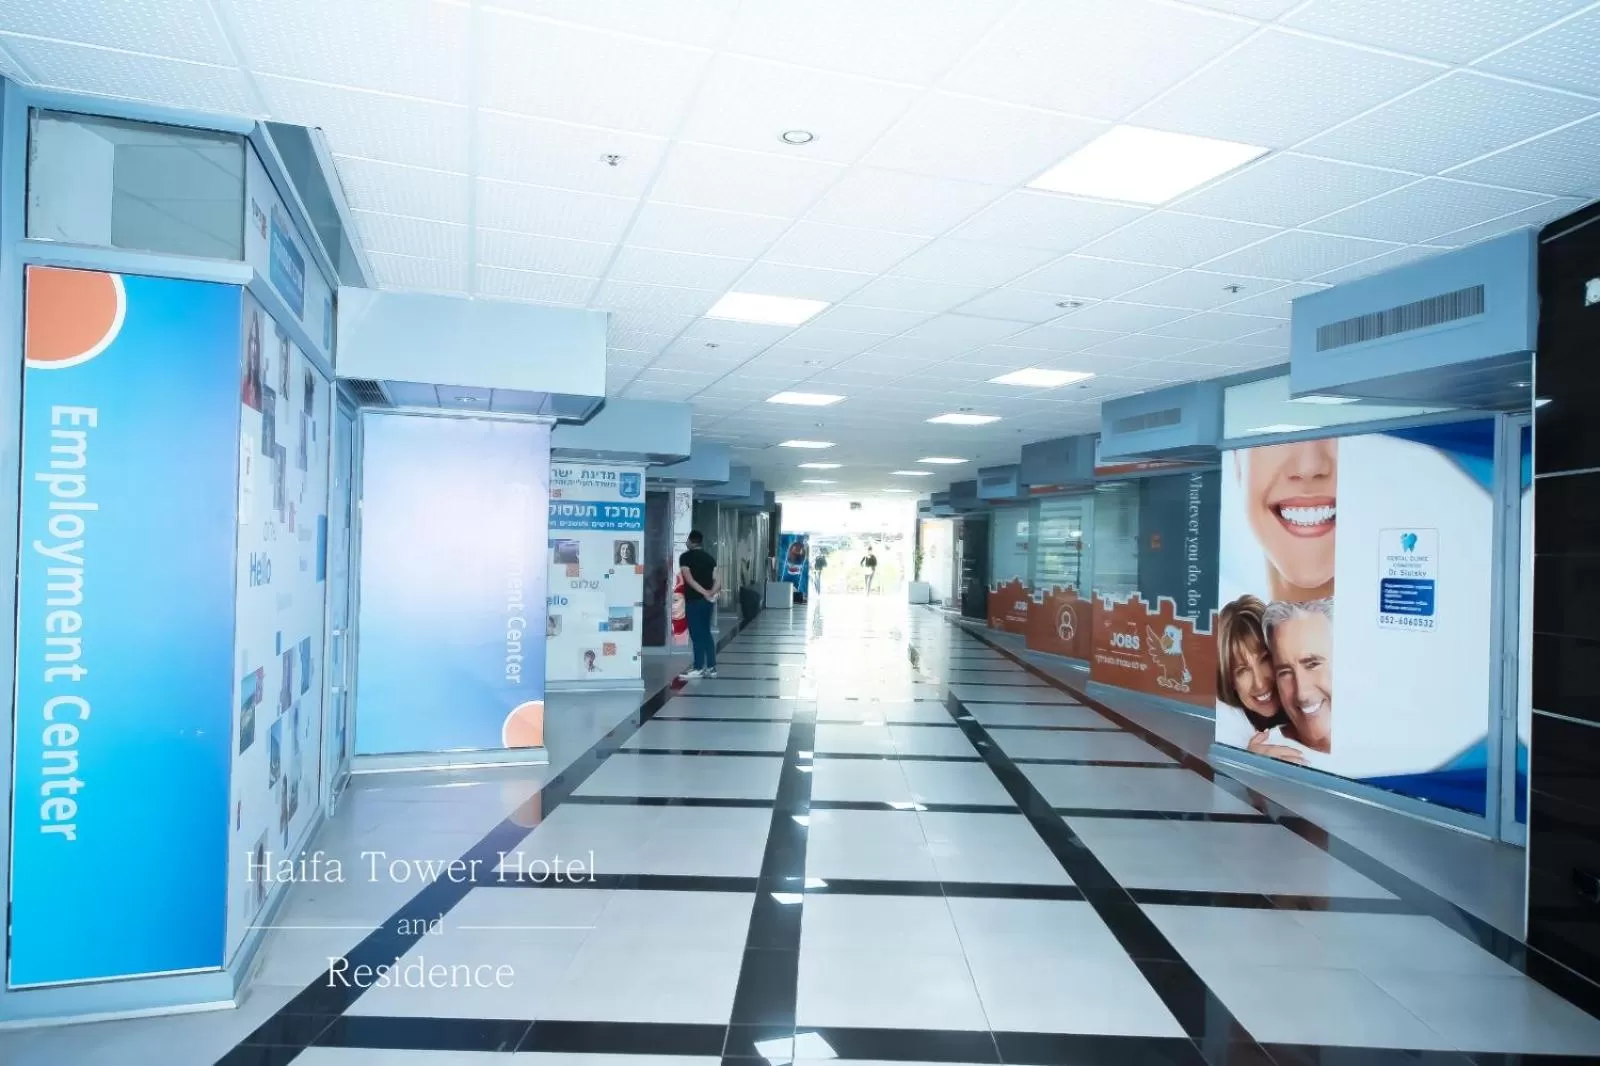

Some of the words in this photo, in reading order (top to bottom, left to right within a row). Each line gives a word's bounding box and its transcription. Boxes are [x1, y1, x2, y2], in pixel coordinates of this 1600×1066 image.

[580, 469, 617, 480] מדינת
[604, 505, 641, 519] מרכז
[33, 405, 99, 682] Employment
[1185, 536, 1200, 561] you
[570, 580, 600, 590] שלום
[1187, 589, 1202, 606] do
[504, 616, 527, 684] Center
[1110, 632, 1140, 650] JOBS
[40, 695, 91, 840] Center
